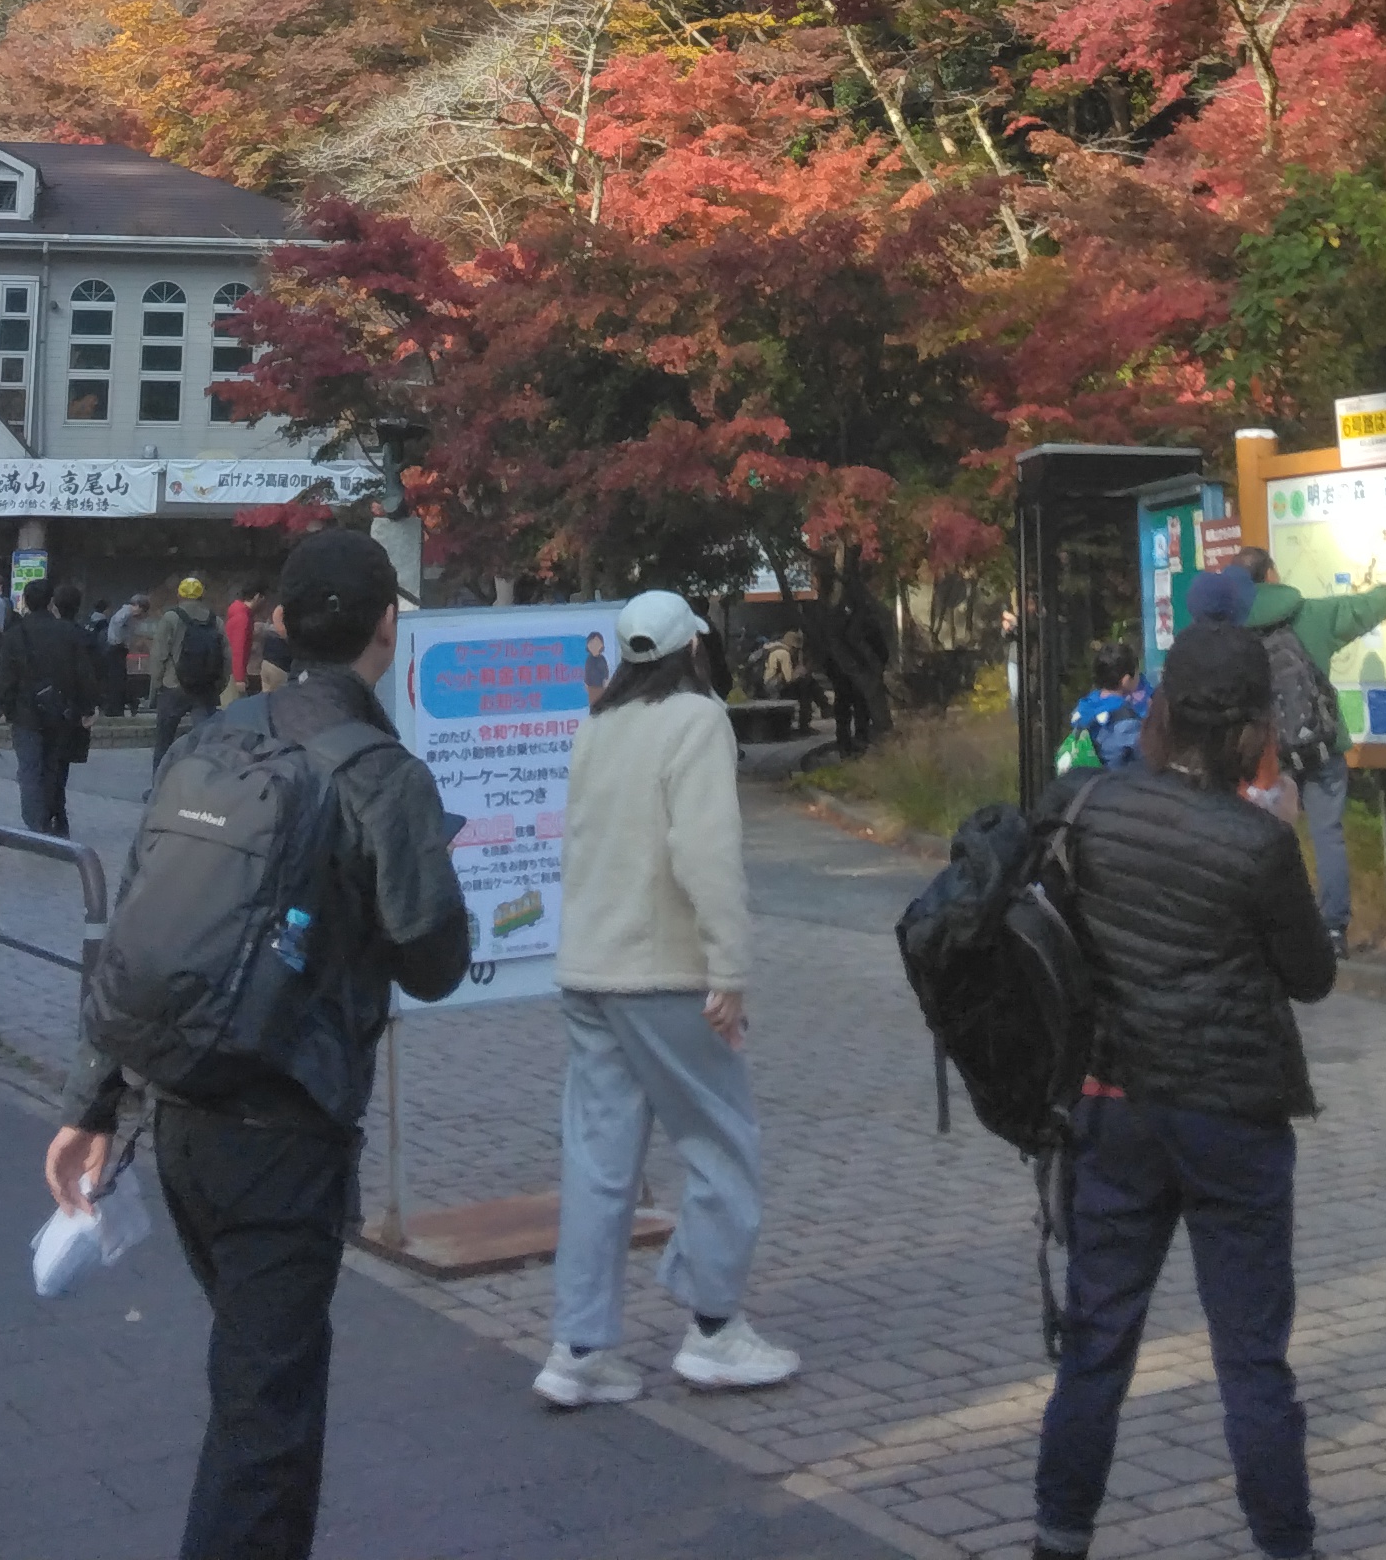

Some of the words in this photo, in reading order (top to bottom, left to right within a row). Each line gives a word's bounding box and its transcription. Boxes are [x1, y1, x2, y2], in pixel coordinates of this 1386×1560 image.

[58, 469, 130, 497] 高尾山
[455, 641, 563, 662] ケーブルカーの
[436, 663, 585, 688] ペット料金有料化の
[480, 692, 542, 711] お知らせ
[484, 787, 548, 808] 1つにつき
